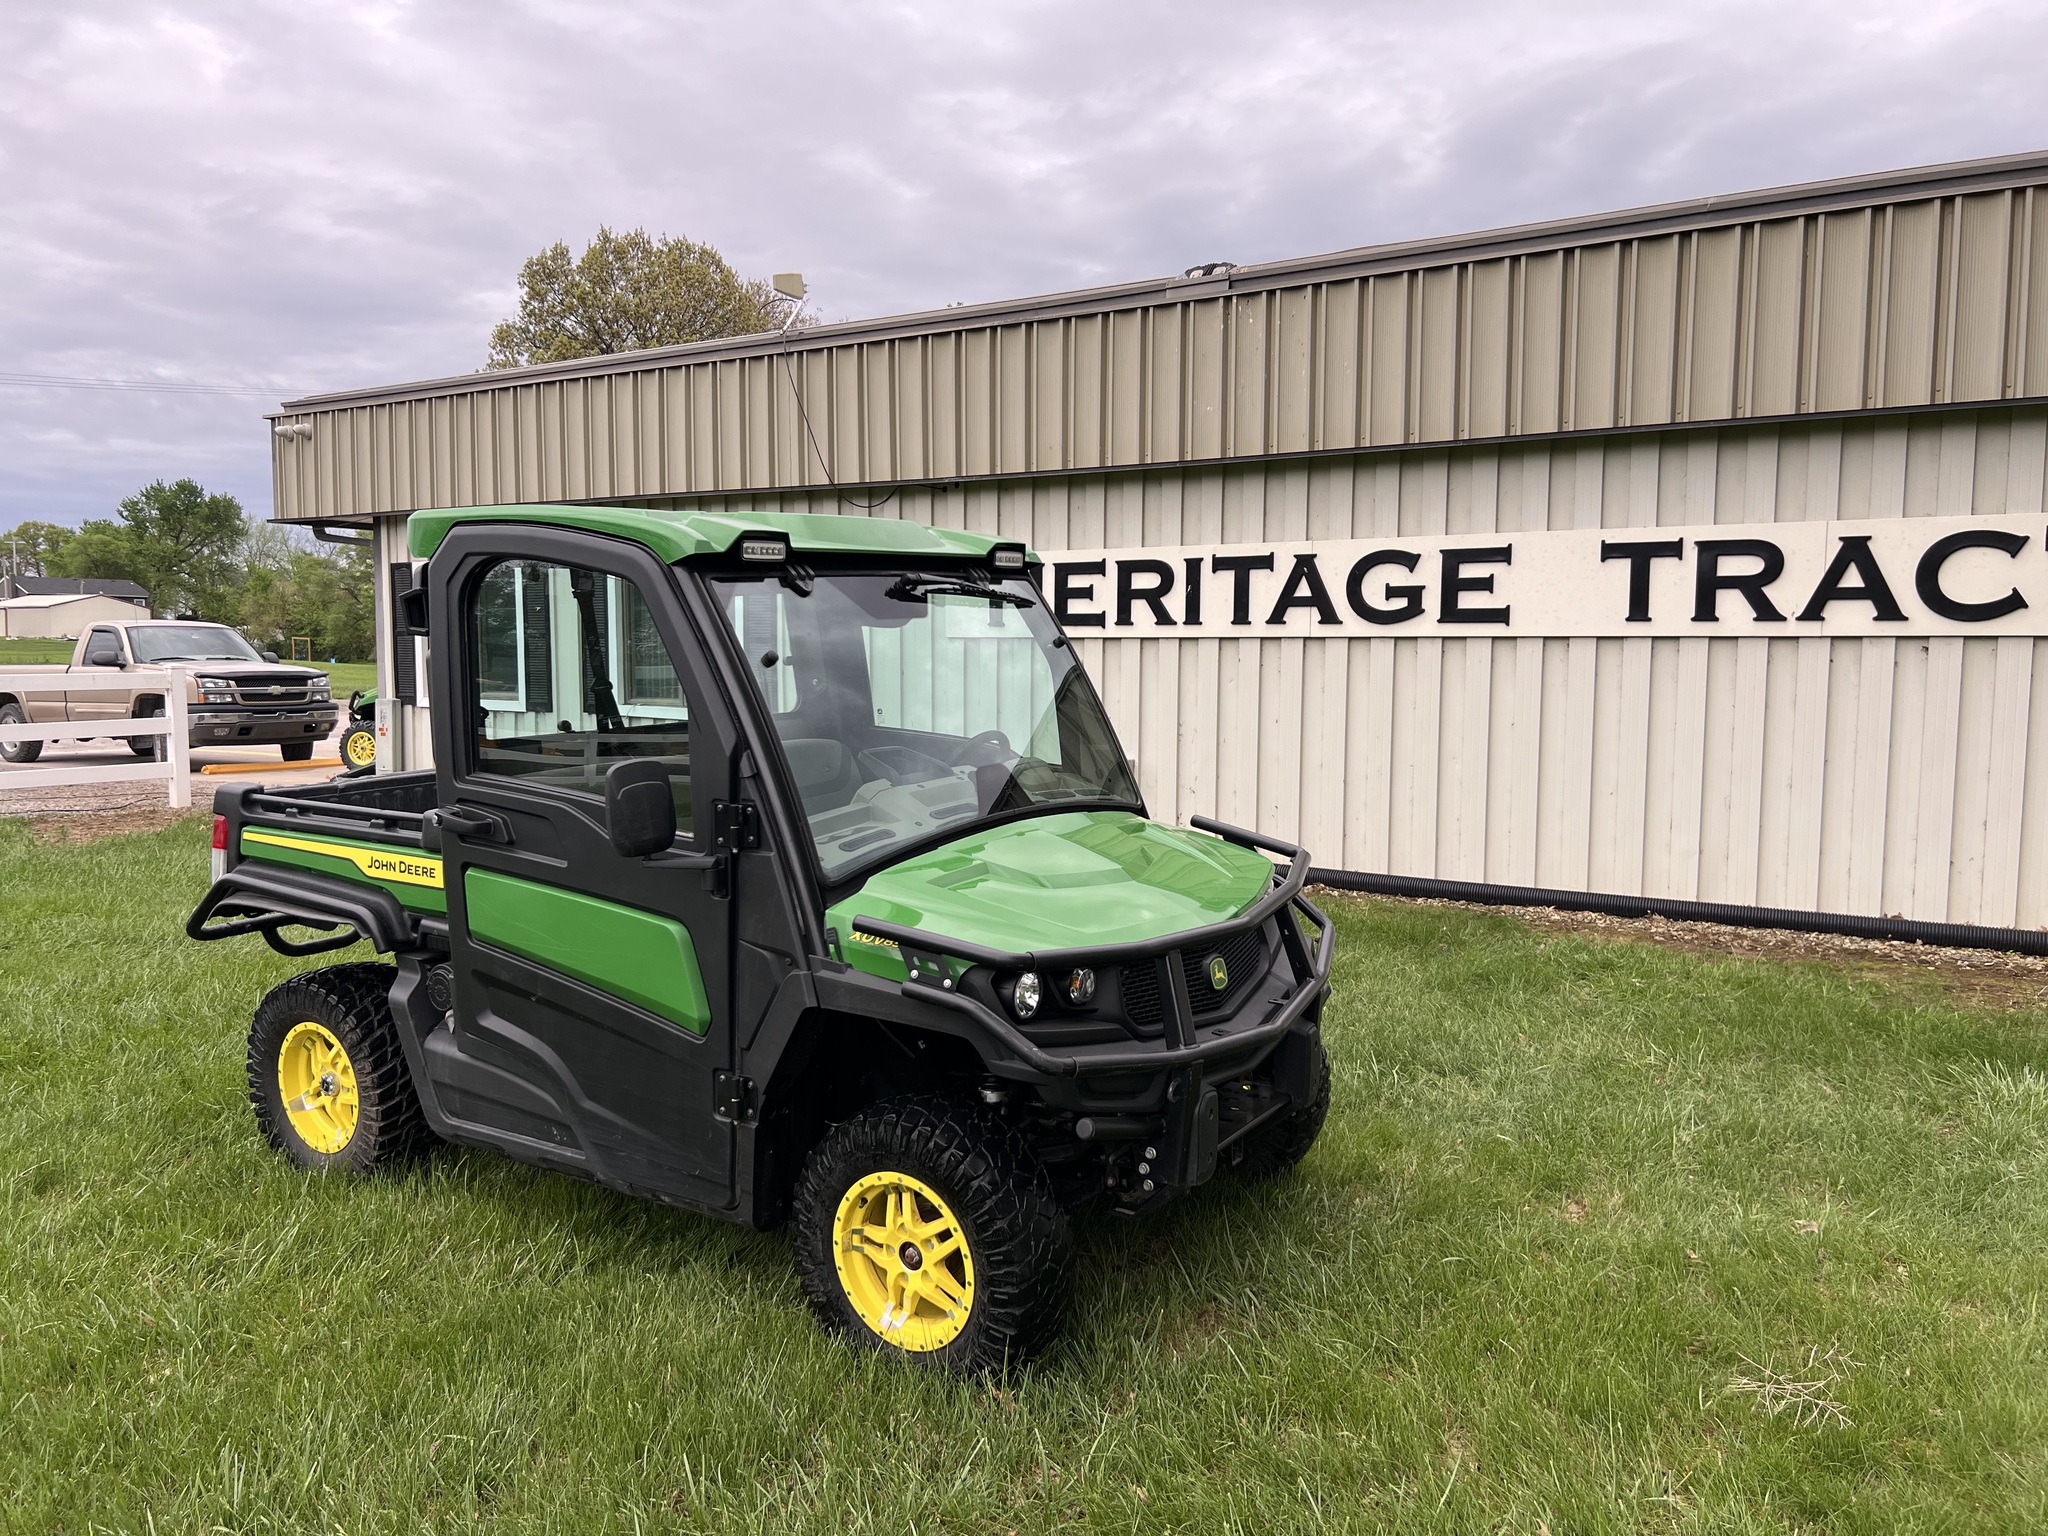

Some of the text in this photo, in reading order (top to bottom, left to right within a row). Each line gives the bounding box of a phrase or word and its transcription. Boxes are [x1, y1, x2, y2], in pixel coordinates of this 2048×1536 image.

[1600, 526, 2048, 623] TRAC
[367, 857, 436, 878] JOHN DEERE
